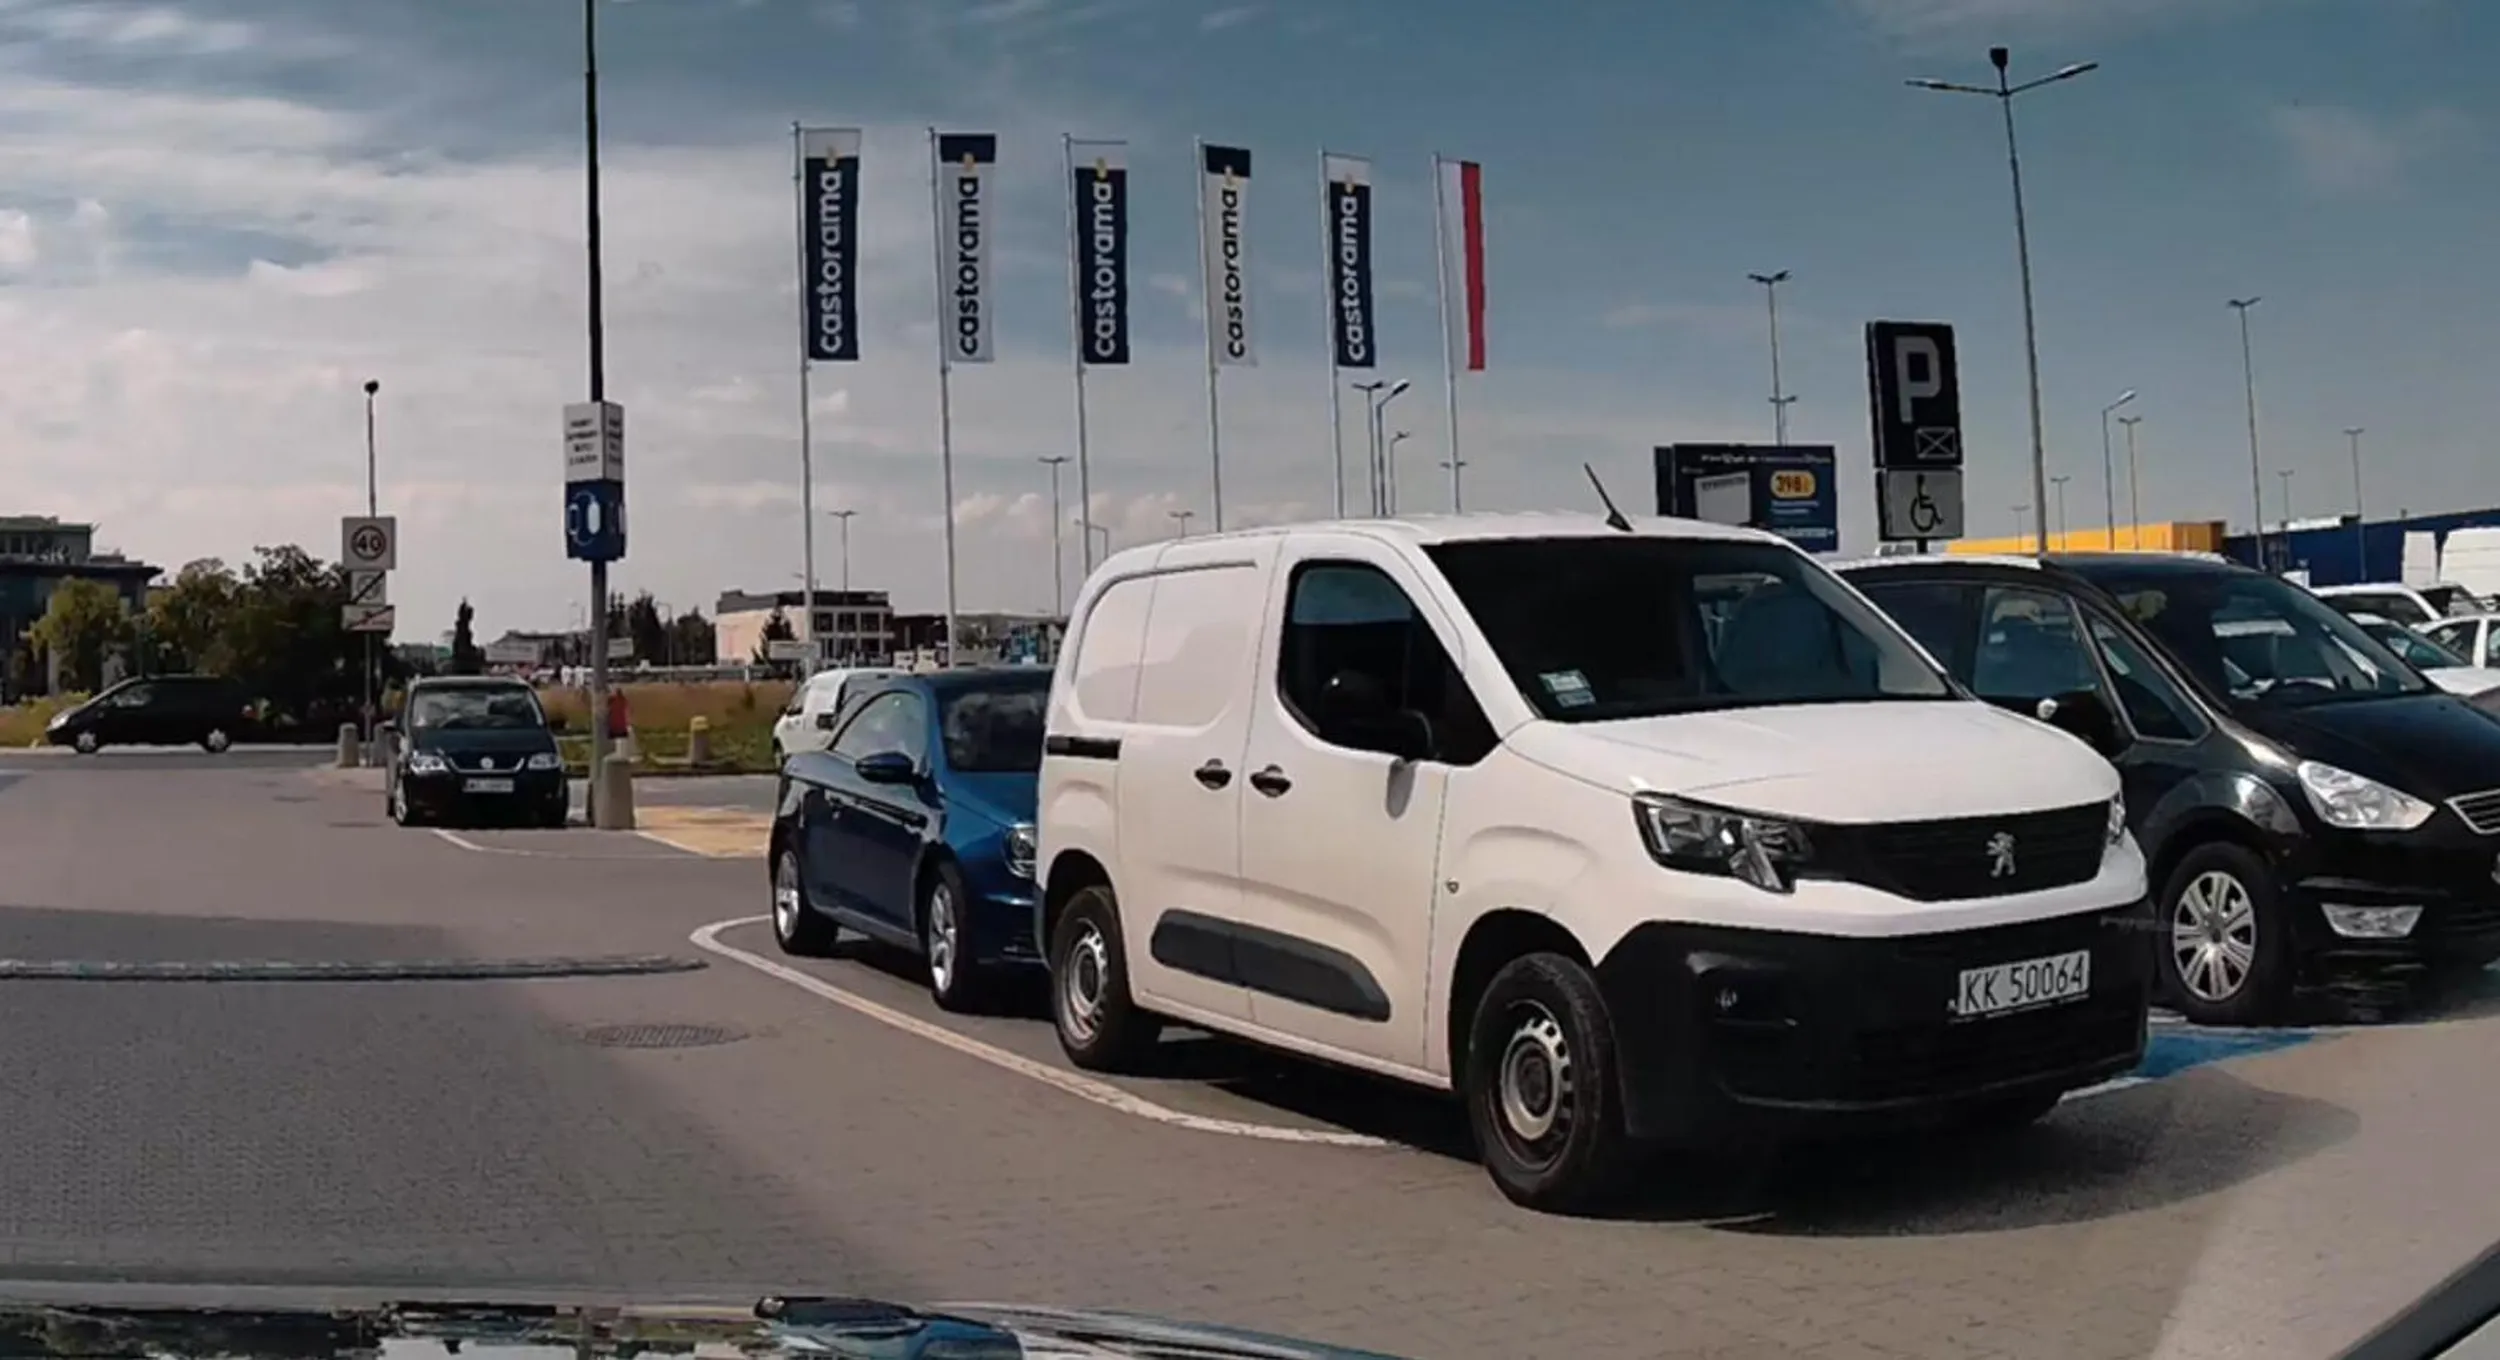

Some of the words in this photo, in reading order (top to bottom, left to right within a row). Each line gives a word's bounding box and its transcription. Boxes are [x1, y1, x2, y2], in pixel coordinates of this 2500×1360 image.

[816, 170, 843, 352] castorama
[954, 176, 980, 356] castorama
[1090, 181, 1117, 358] castorama
[1221, 188, 1245, 359] castorama
[1340, 195, 1366, 362] castorama
[1894, 335, 1942, 424] P
[357, 534, 381, 551] 40
[1965, 969, 2001, 1012] KK
[2009, 954, 2085, 1004] 50064
